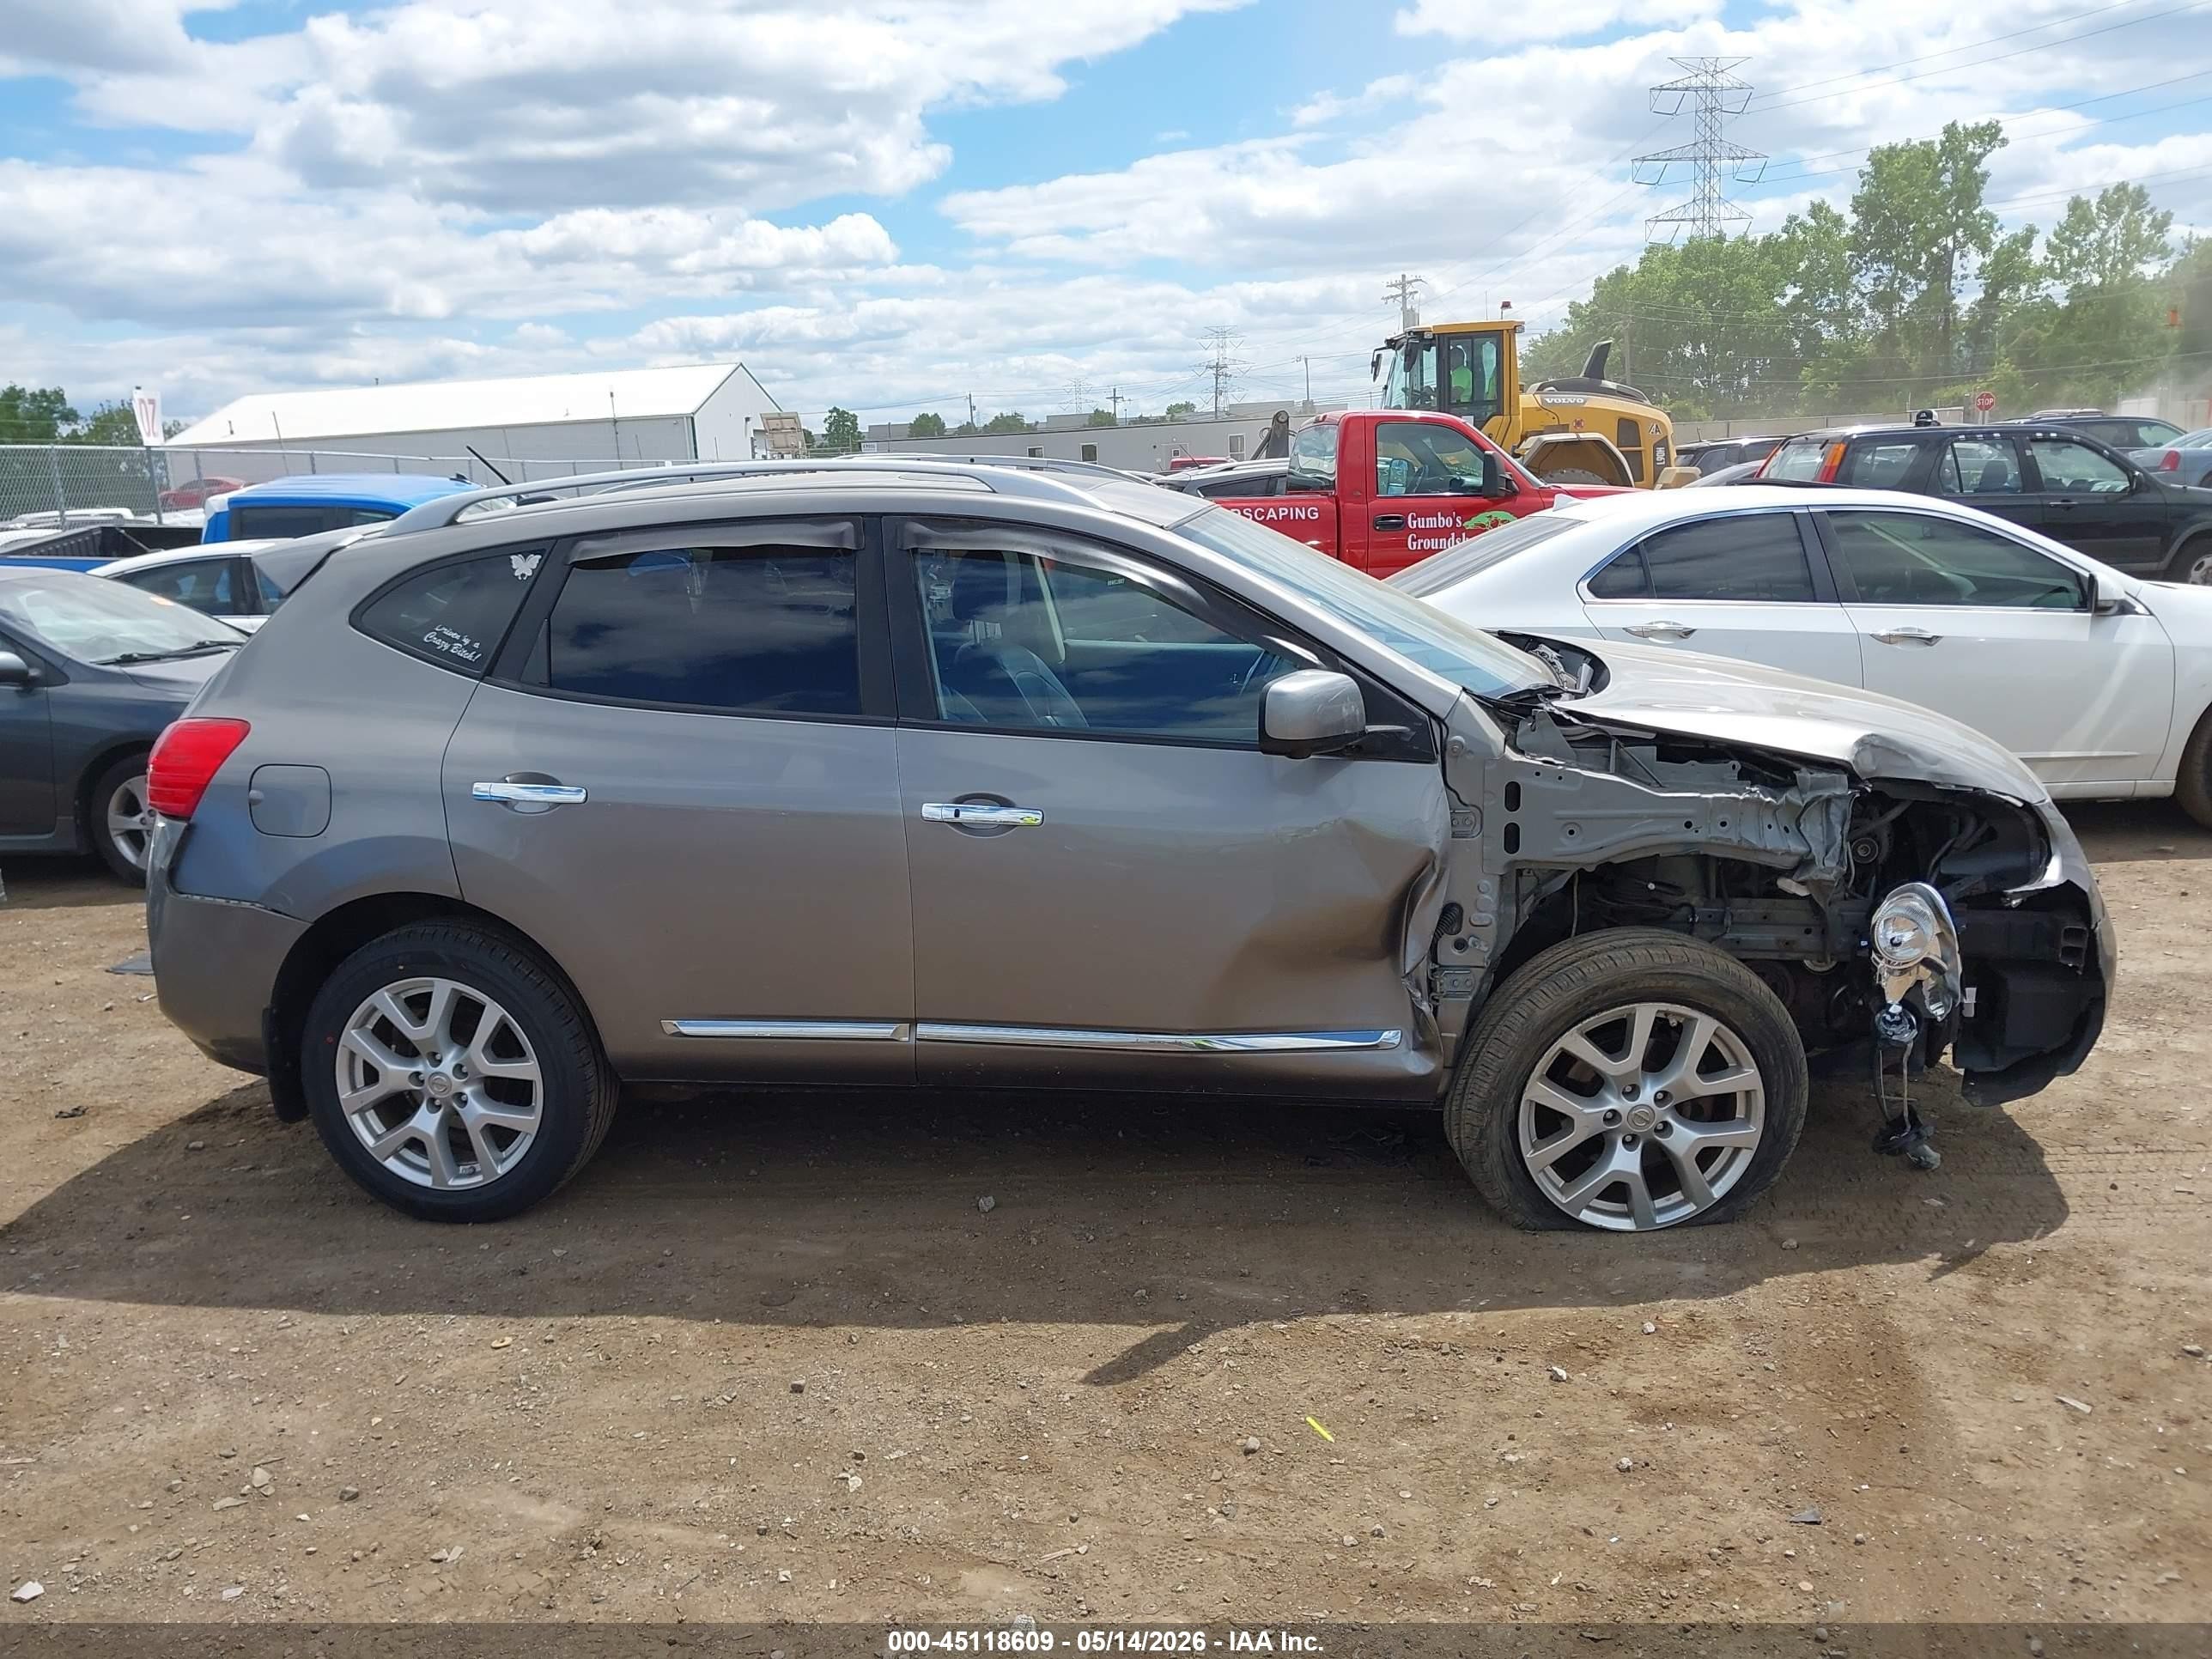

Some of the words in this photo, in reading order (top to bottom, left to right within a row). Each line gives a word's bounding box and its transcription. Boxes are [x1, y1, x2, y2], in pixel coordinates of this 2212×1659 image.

[1656, 447, 1666, 465] L90H
[1407, 512, 1462, 529] Gumbo's
[423, 631, 451, 652] Crazy
[450, 643, 482, 662] Bitch!
